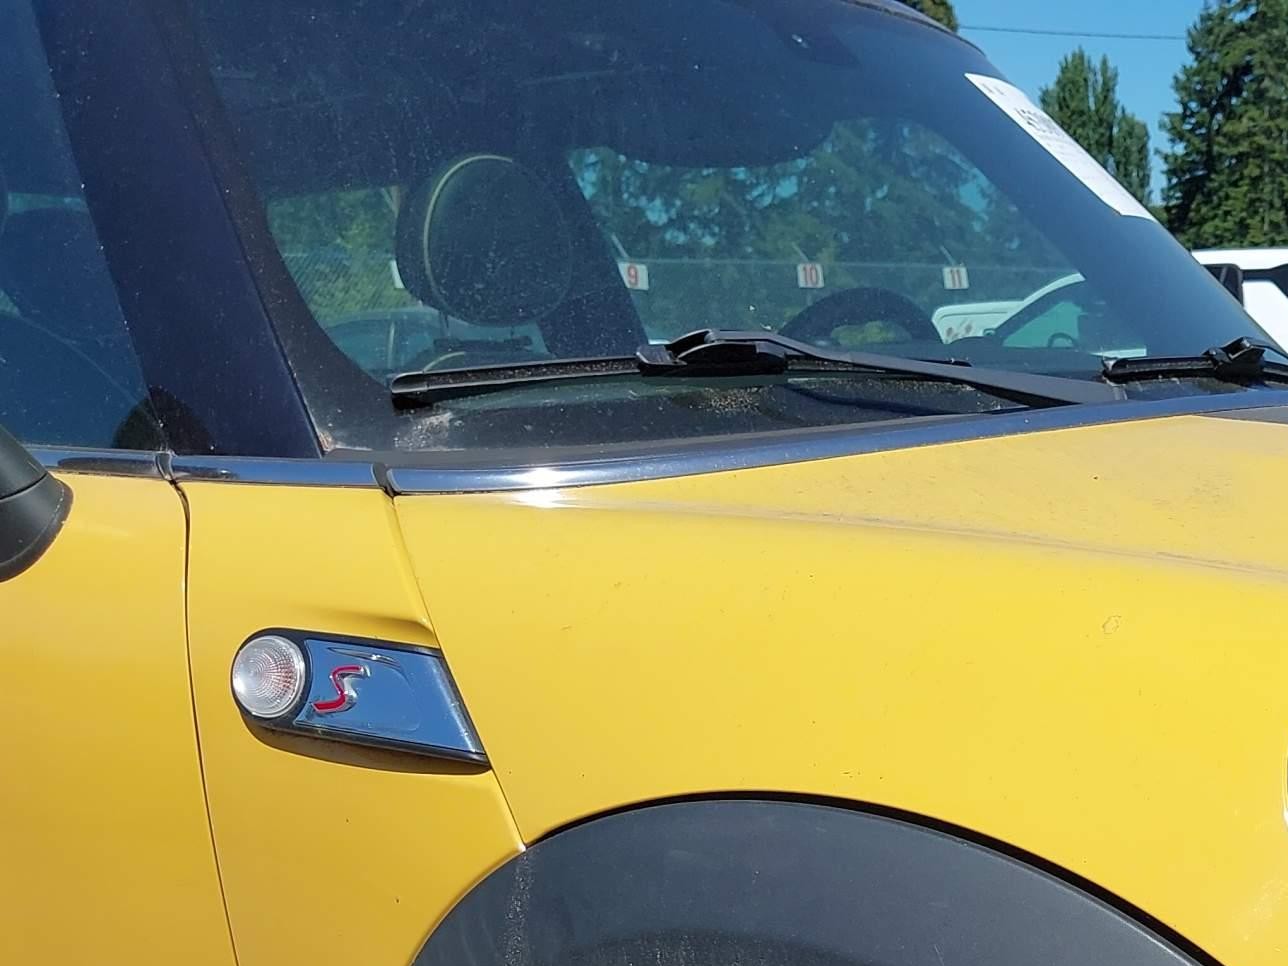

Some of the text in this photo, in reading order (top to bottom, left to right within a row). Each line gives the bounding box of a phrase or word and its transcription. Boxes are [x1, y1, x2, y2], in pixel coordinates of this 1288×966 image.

[627, 263, 639, 287] 9
[802, 265, 819, 287] 10
[311, 665, 371, 713] S
